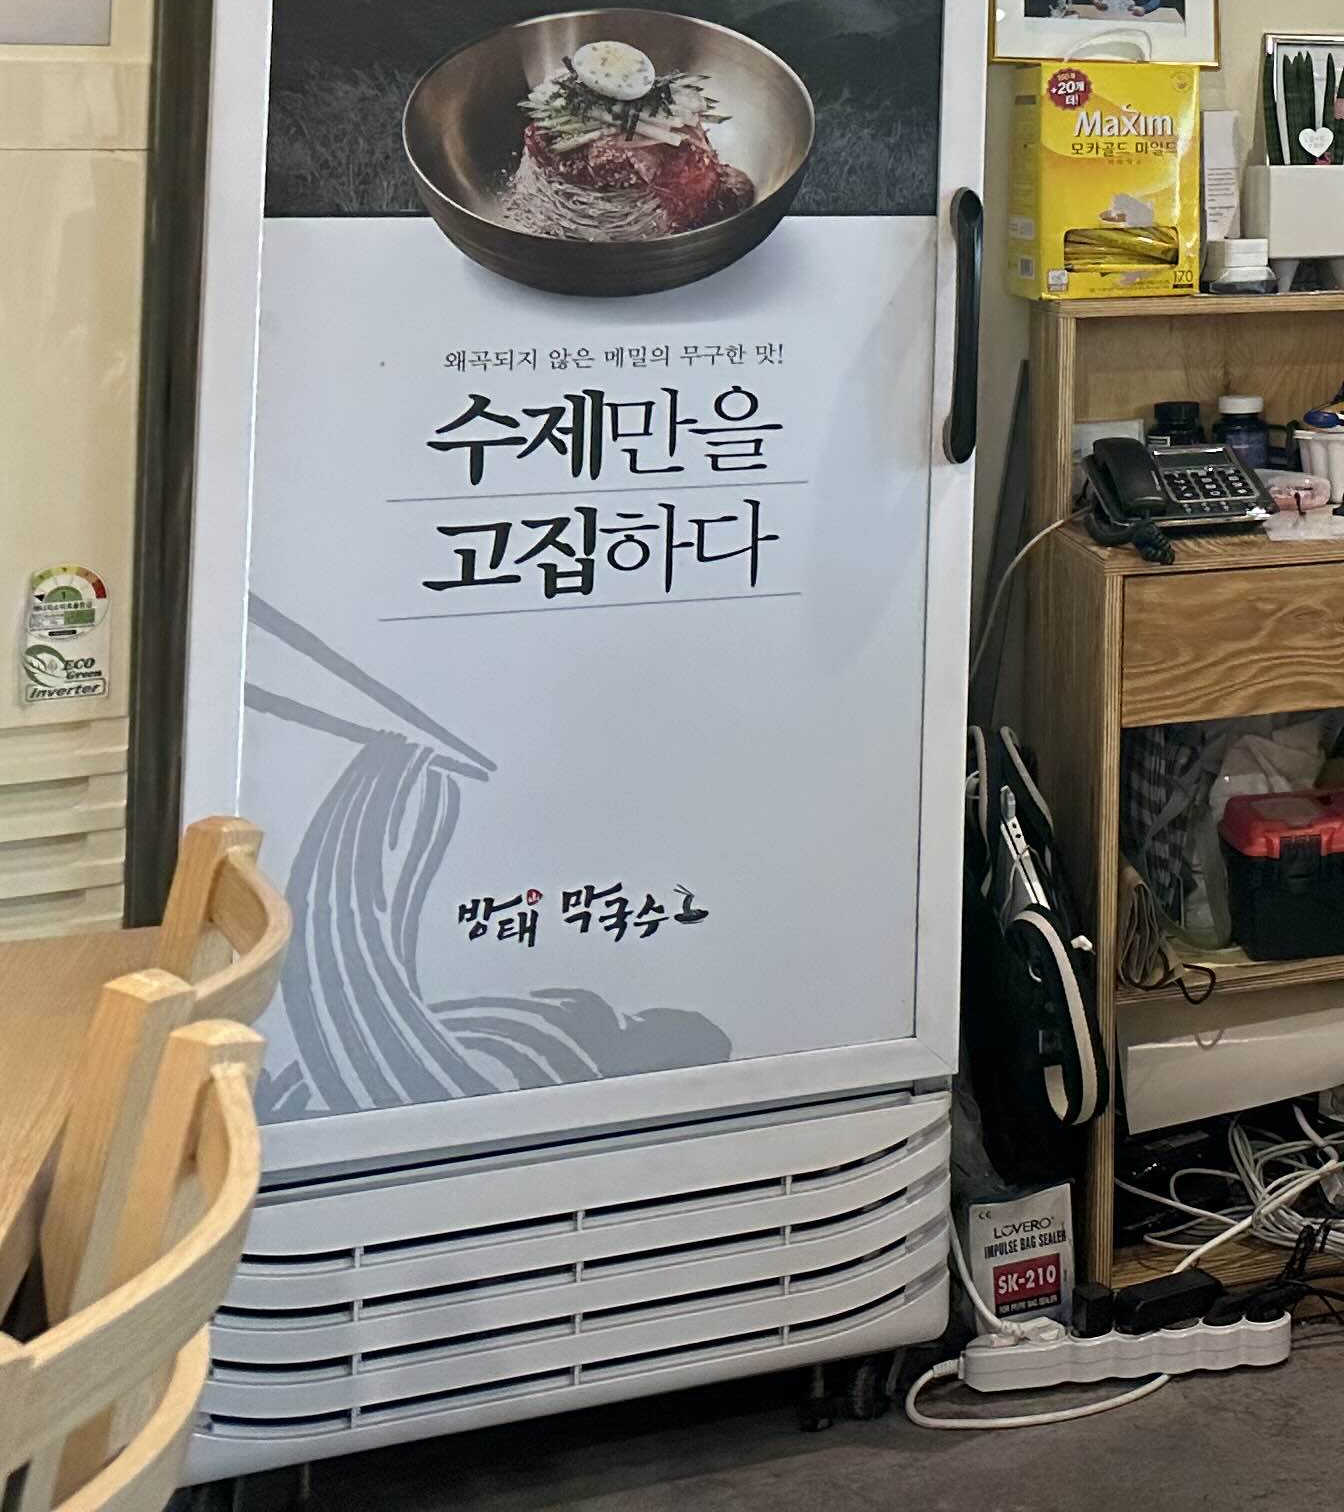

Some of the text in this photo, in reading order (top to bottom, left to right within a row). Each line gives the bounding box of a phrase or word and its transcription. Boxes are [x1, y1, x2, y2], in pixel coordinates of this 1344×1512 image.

[1074, 105, 1174, 138] Maxim
[1071, 140, 1178, 157] 모카골드 마일드
[444, 342, 784, 372] 왜곡되지 않은 메밀의 무구한 맛!
[426, 385, 783, 486] 수제만을
[422, 498, 780, 599] 고집하다
[64, 658, 95, 671] ECO
[30, 683, 100, 699] Inverter
[458, 882, 670, 948] 방태 막국수
[993, 1217, 1052, 1239] LOVERO
[984, 1230, 1067, 1259] IMPULSE BAG SEALER
[998, 1264, 1057, 1295] SK-210
